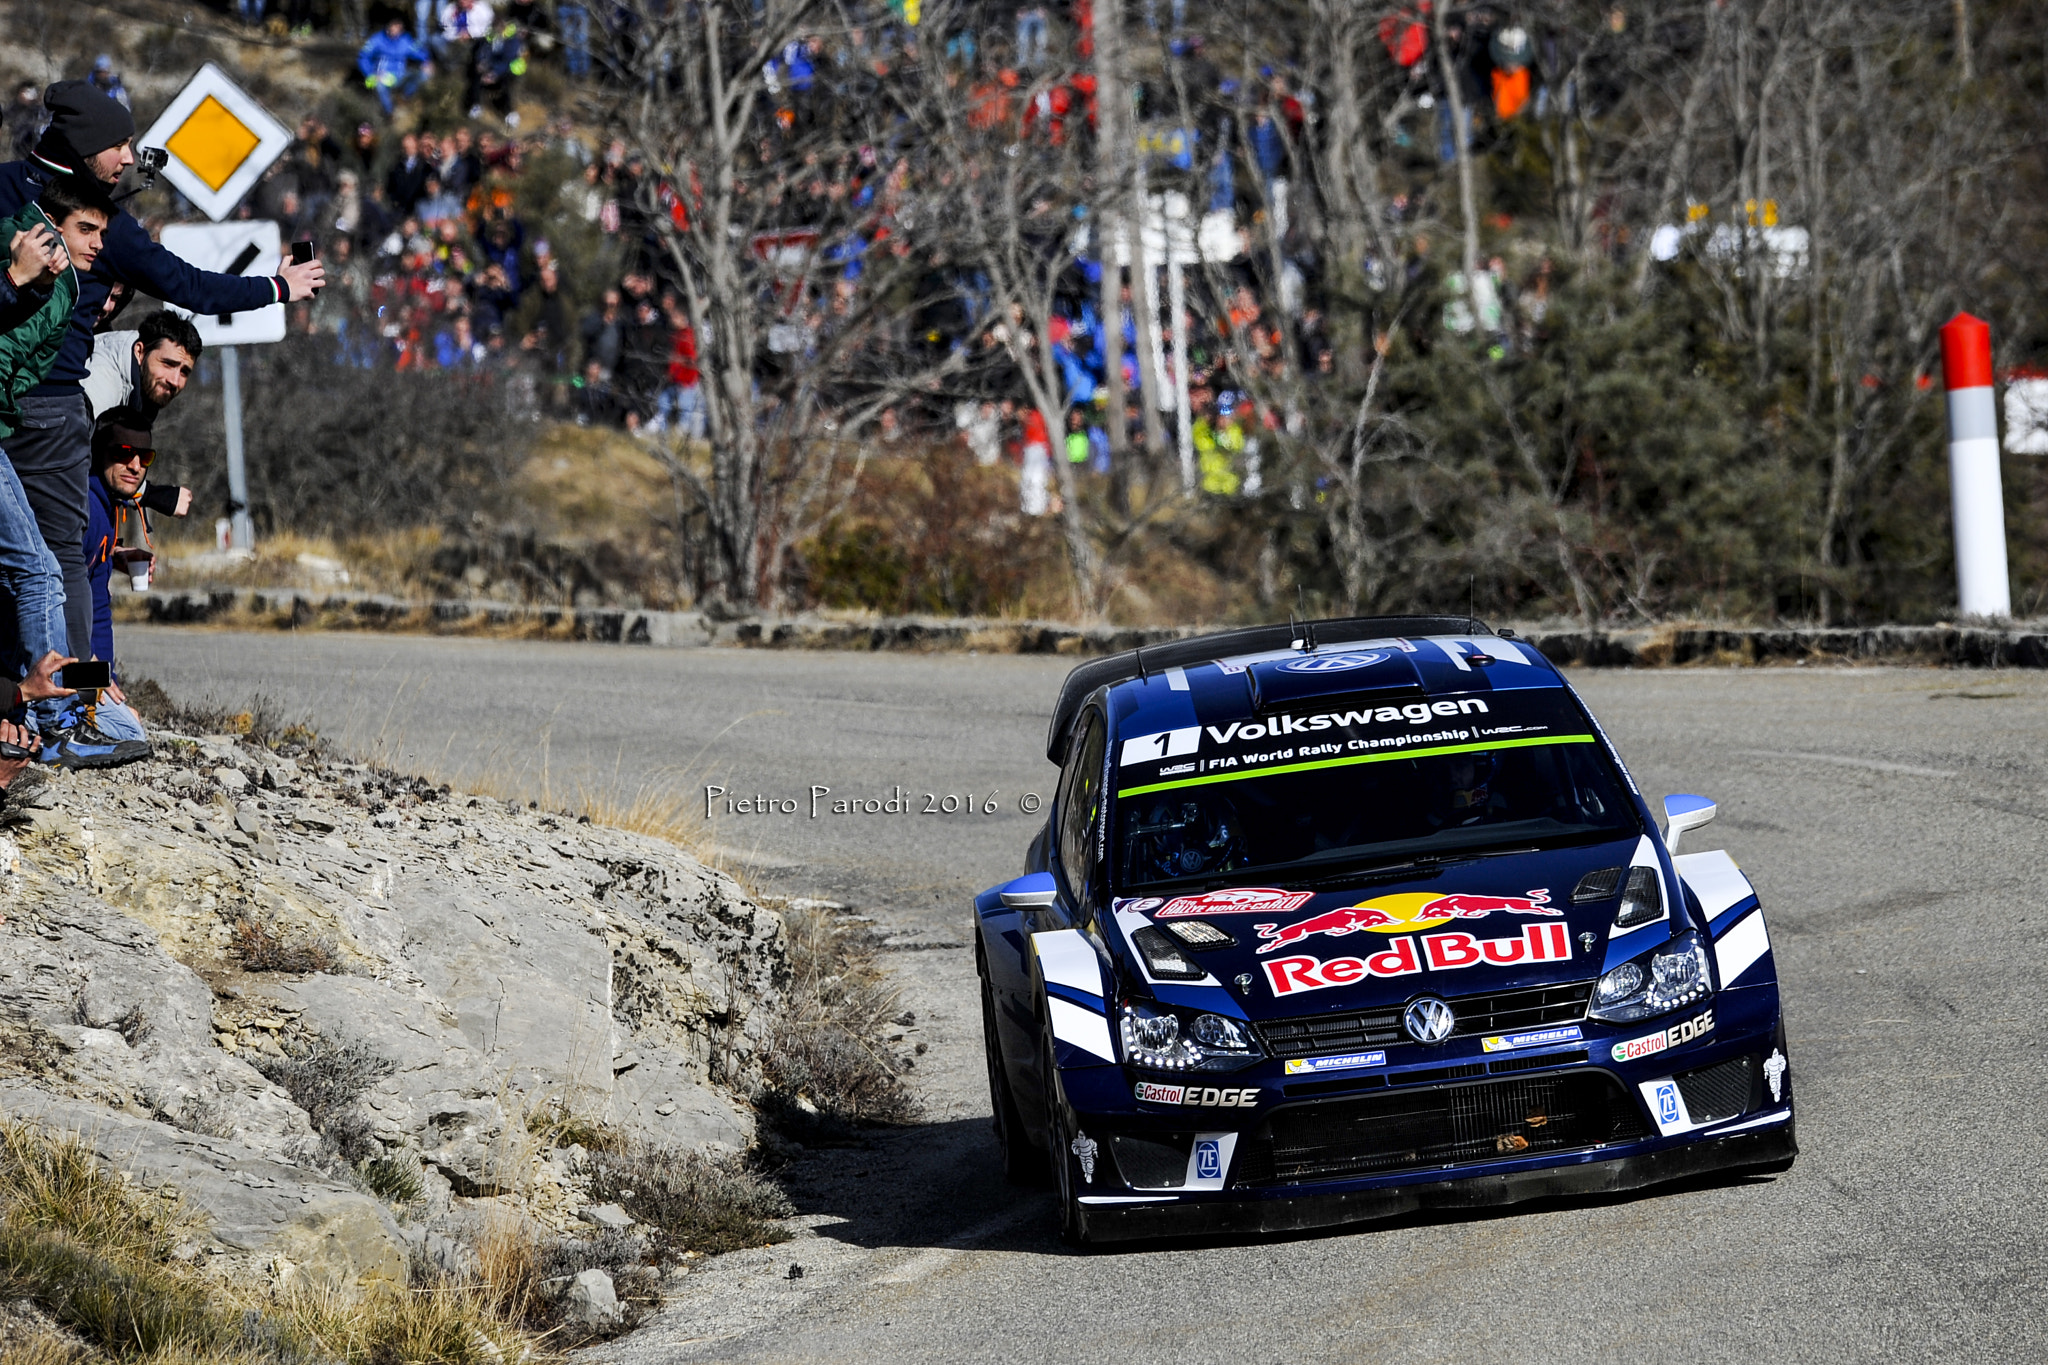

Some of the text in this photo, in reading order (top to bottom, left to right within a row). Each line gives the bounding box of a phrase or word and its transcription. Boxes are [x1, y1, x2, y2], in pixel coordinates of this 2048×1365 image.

[1206, 697, 1489, 744] Volkswagen
[1153, 732, 1171, 757] 1
[1209, 757, 1238, 770] FIA
[1242, 748, 1294, 765] World
[1298, 742, 1343, 758] Rally
[1347, 729, 1469, 751] Championship
[1162, 900, 1207, 915] RALLYE
[1264, 922, 1570, 995] Red Bull
[1512, 1027, 1578, 1045] MICHELIN
[1626, 1009, 1715, 1060] Castrol EDGE
[1314, 1053, 1384, 1068] MICHELIN
[1144, 1084, 1262, 1107] Castrol EDGE
